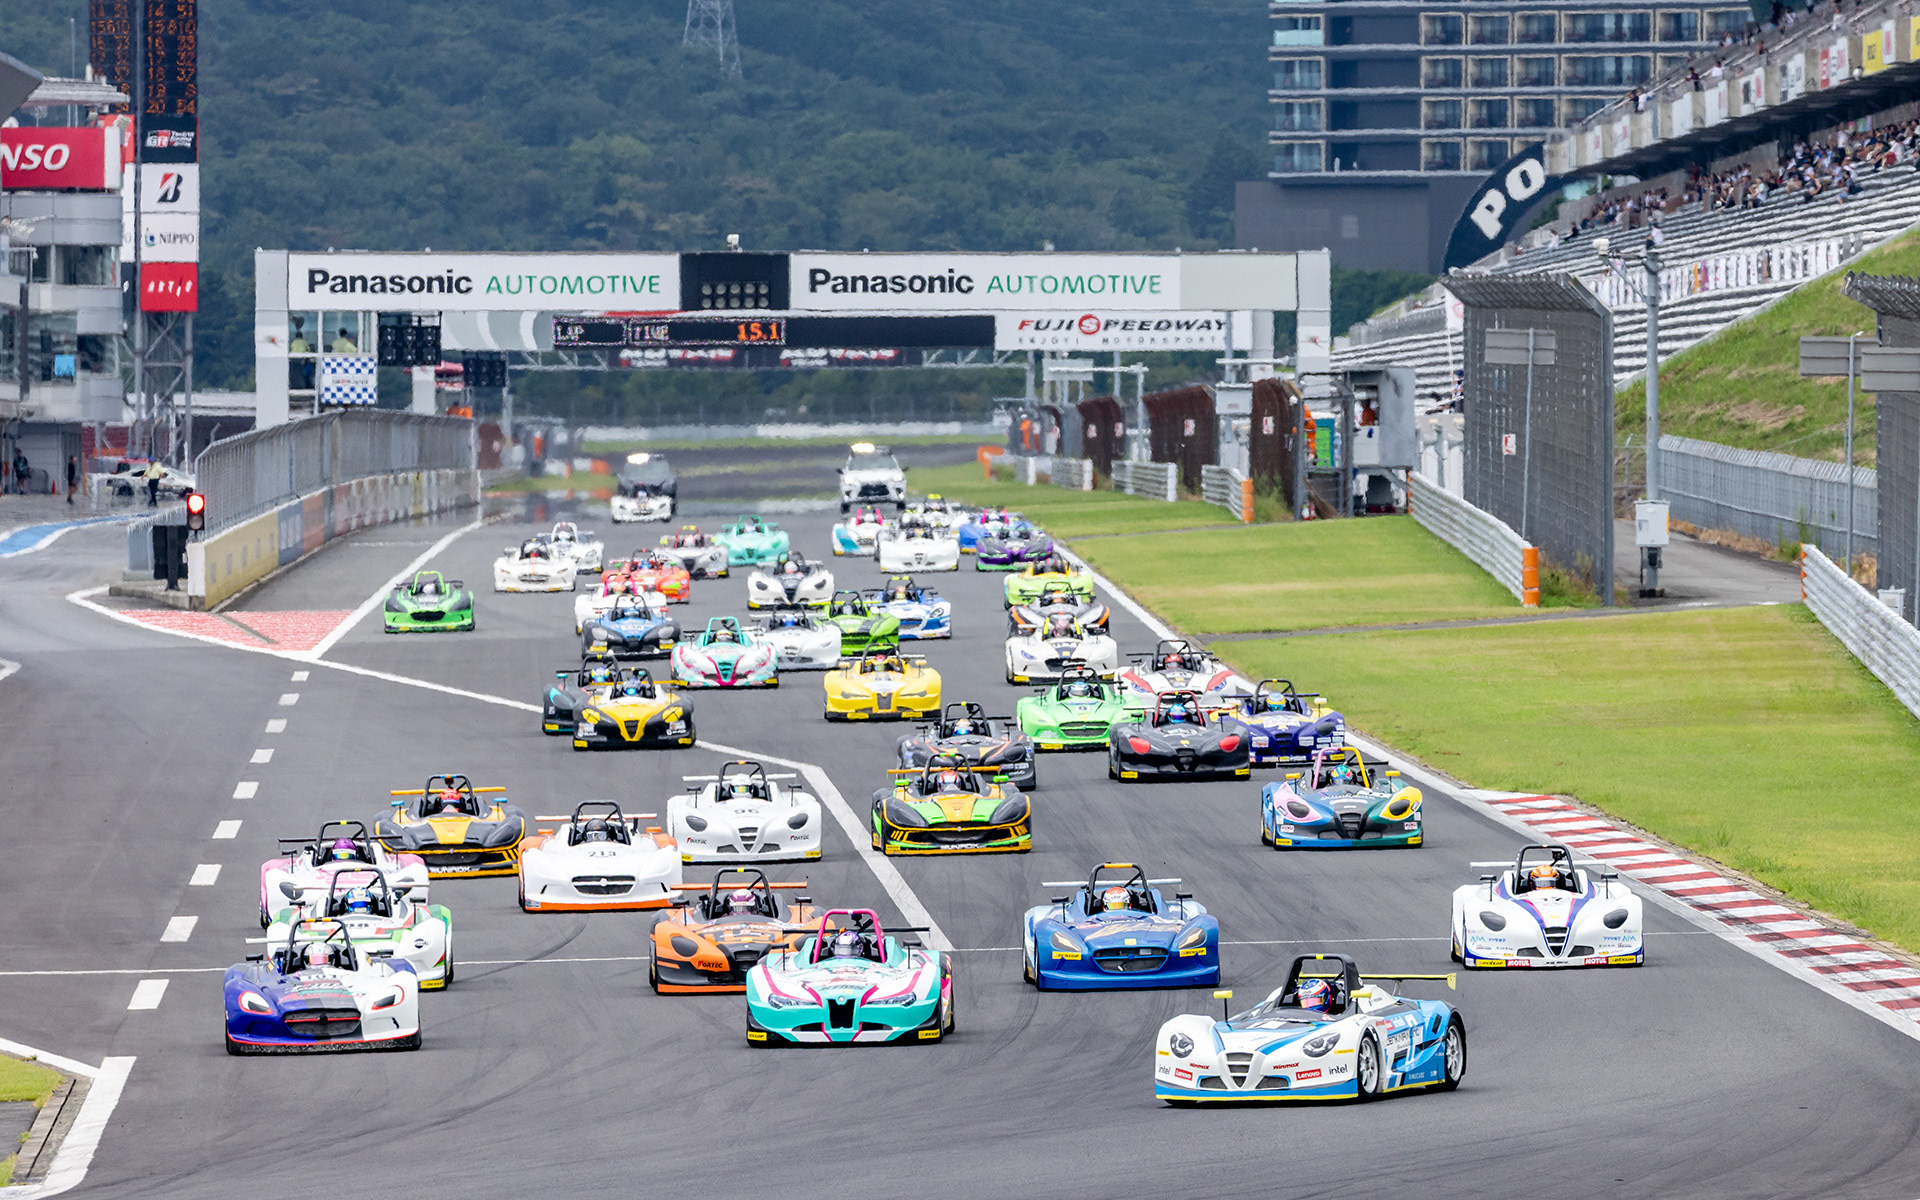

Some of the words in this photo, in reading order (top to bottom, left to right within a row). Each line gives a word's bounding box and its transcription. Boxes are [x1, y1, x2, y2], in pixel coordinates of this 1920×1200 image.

[159, 232, 195, 244] NIPPO
[308, 268, 473, 294] Panasonic
[485, 275, 662, 295] AUTOMOTIVE
[809, 268, 975, 294] Panasonic
[986, 275, 1162, 295] AUTOMOTIVE
[1018, 319, 1074, 332] FUJI
[1078, 313, 1227, 336] SPEEDWAY
[737, 322, 781, 342] 15.1
[587, 850, 617, 858] 213
[1507, 959, 1530, 967] MOTUL
[1585, 957, 1607, 965] MOTUL
[1175, 1069, 1192, 1080] Lenovo
[1296, 1070, 1321, 1079] Lenovo
[1328, 1063, 1349, 1075] intel
